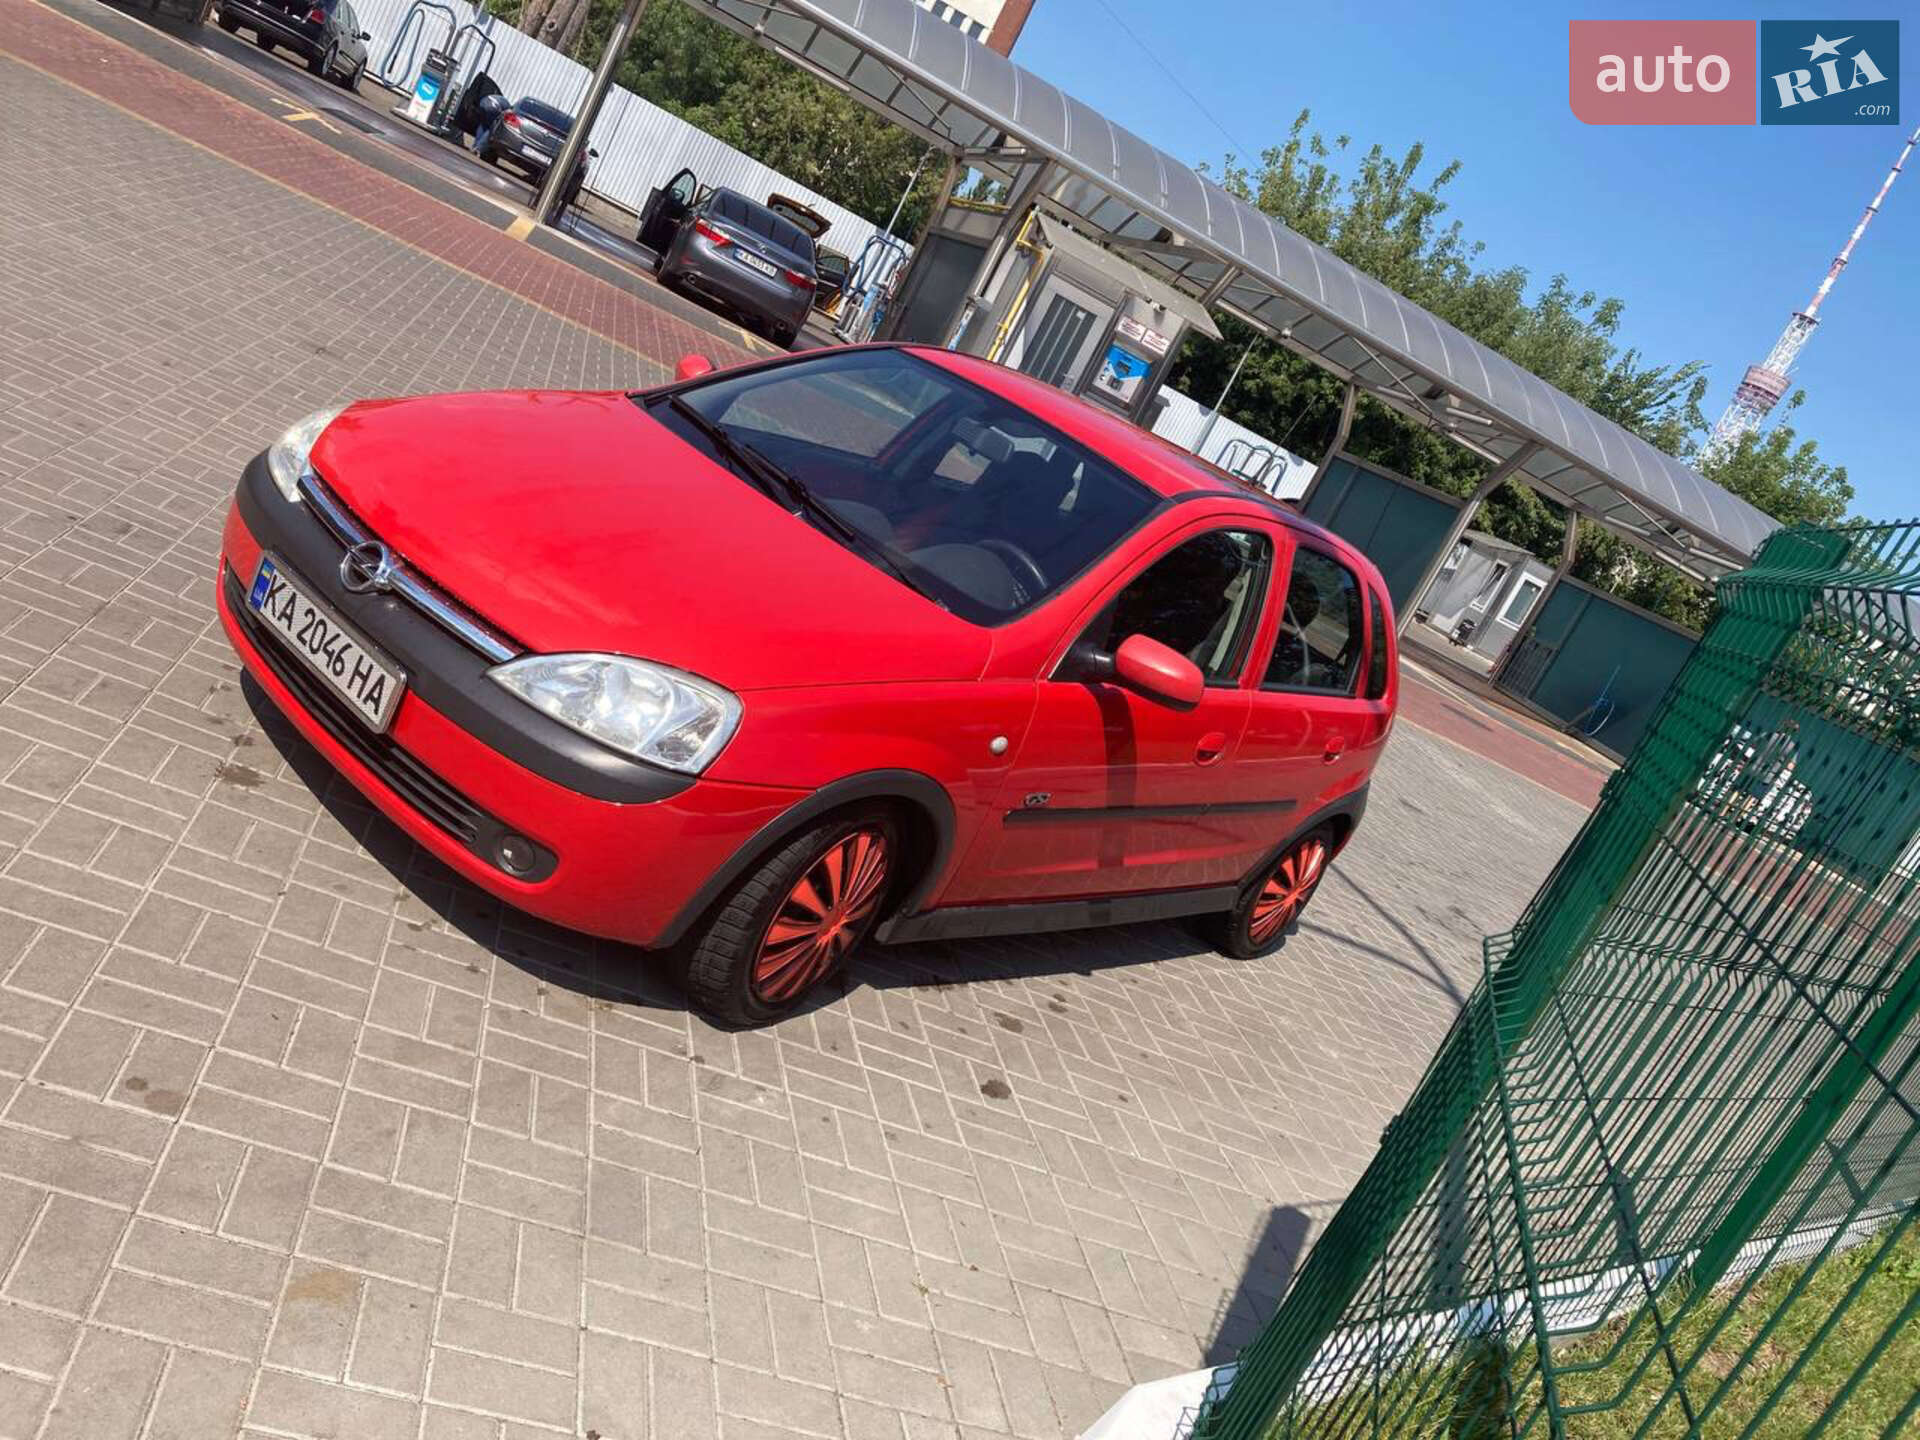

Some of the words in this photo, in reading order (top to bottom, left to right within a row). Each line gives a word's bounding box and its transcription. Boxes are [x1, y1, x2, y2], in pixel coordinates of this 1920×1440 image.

[263, 574, 297, 631] KA
[296, 607, 352, 677] 2046
[347, 655, 386, 715] HA
